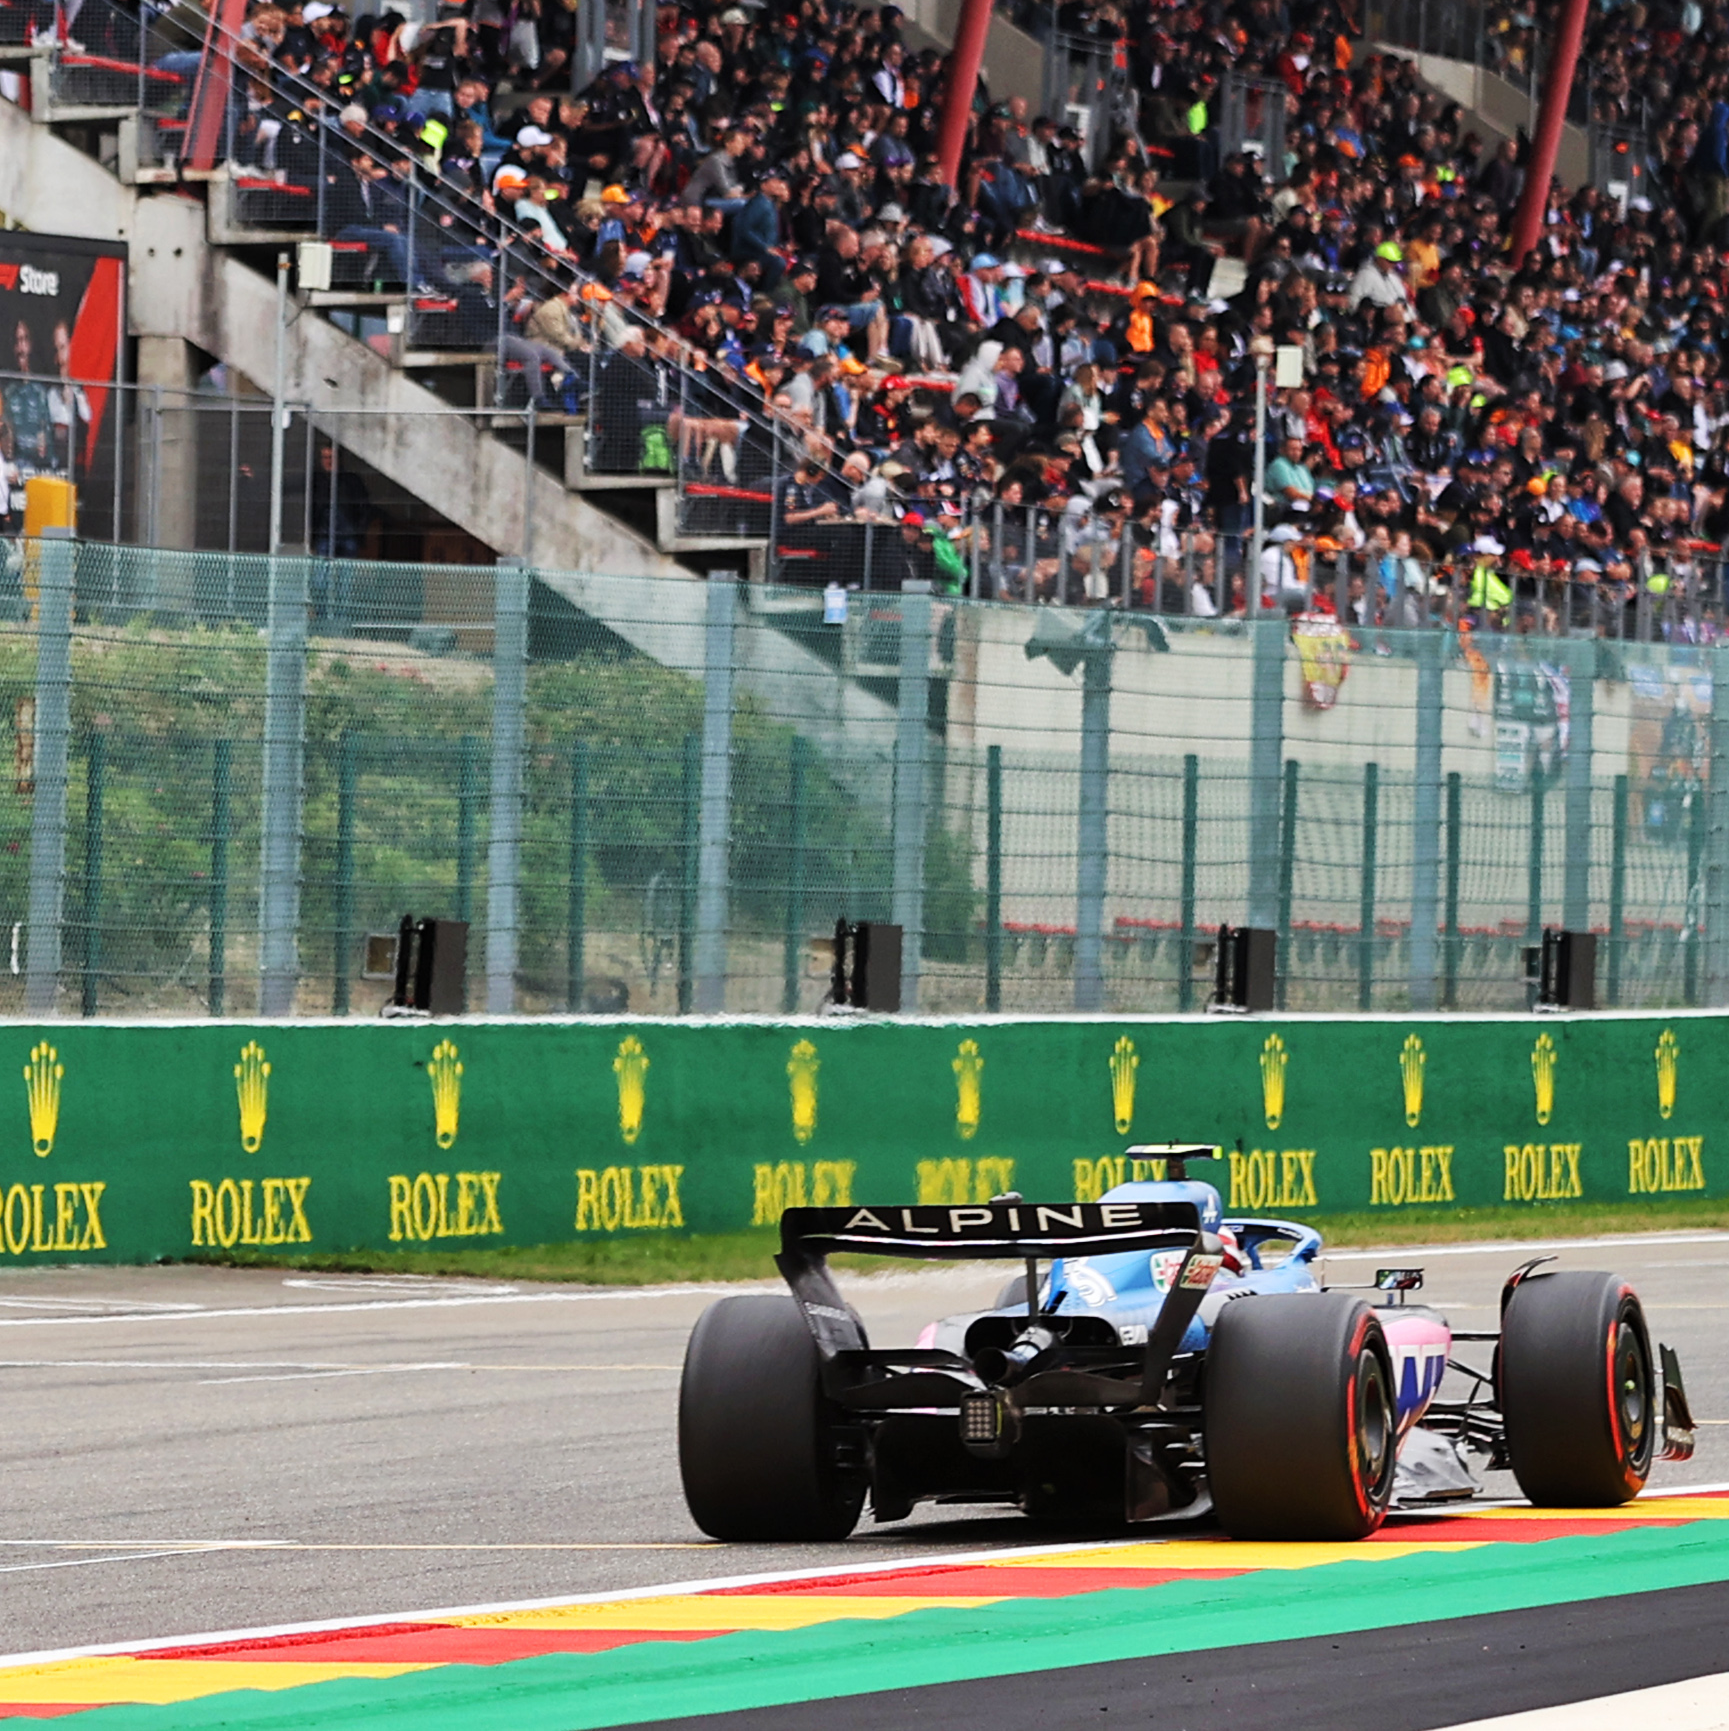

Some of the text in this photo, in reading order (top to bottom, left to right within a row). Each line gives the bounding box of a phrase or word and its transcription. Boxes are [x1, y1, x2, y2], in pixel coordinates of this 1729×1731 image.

[19, 263, 59, 297] Store
[1228, 1150, 1317, 1209] ROLEX
[1370, 1146, 1455, 1204] ROLEX
[1504, 1144, 1582, 1200] ROLEX
[1629, 1137, 1705, 1192] ROLEX
[190, 1177, 312, 1248] ROLEX
[388, 1172, 503, 1241] ROLEX
[576, 1165, 683, 1230] ROLEX
[845, 1204, 1143, 1233] ALPINE
